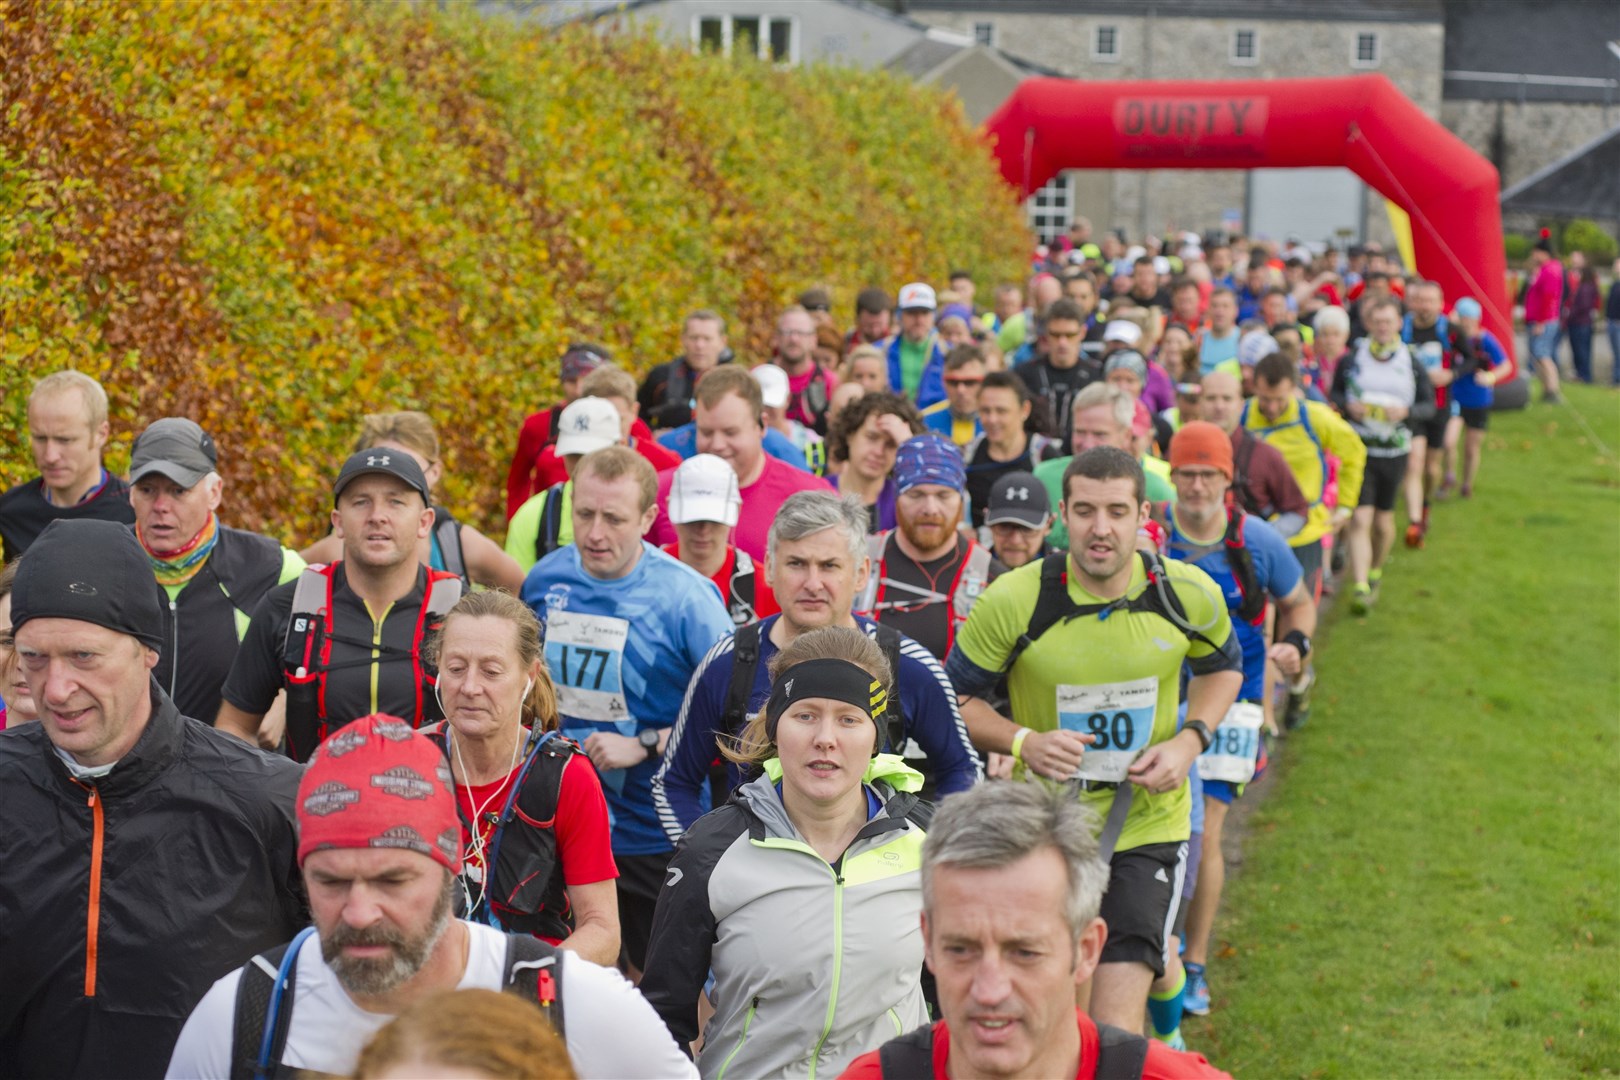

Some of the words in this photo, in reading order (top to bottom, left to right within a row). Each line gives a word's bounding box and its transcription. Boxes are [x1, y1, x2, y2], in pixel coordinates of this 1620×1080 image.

[1123, 100, 1252, 136] DURTY
[561, 645, 610, 690] 177
[1087, 711, 1133, 751] 80
